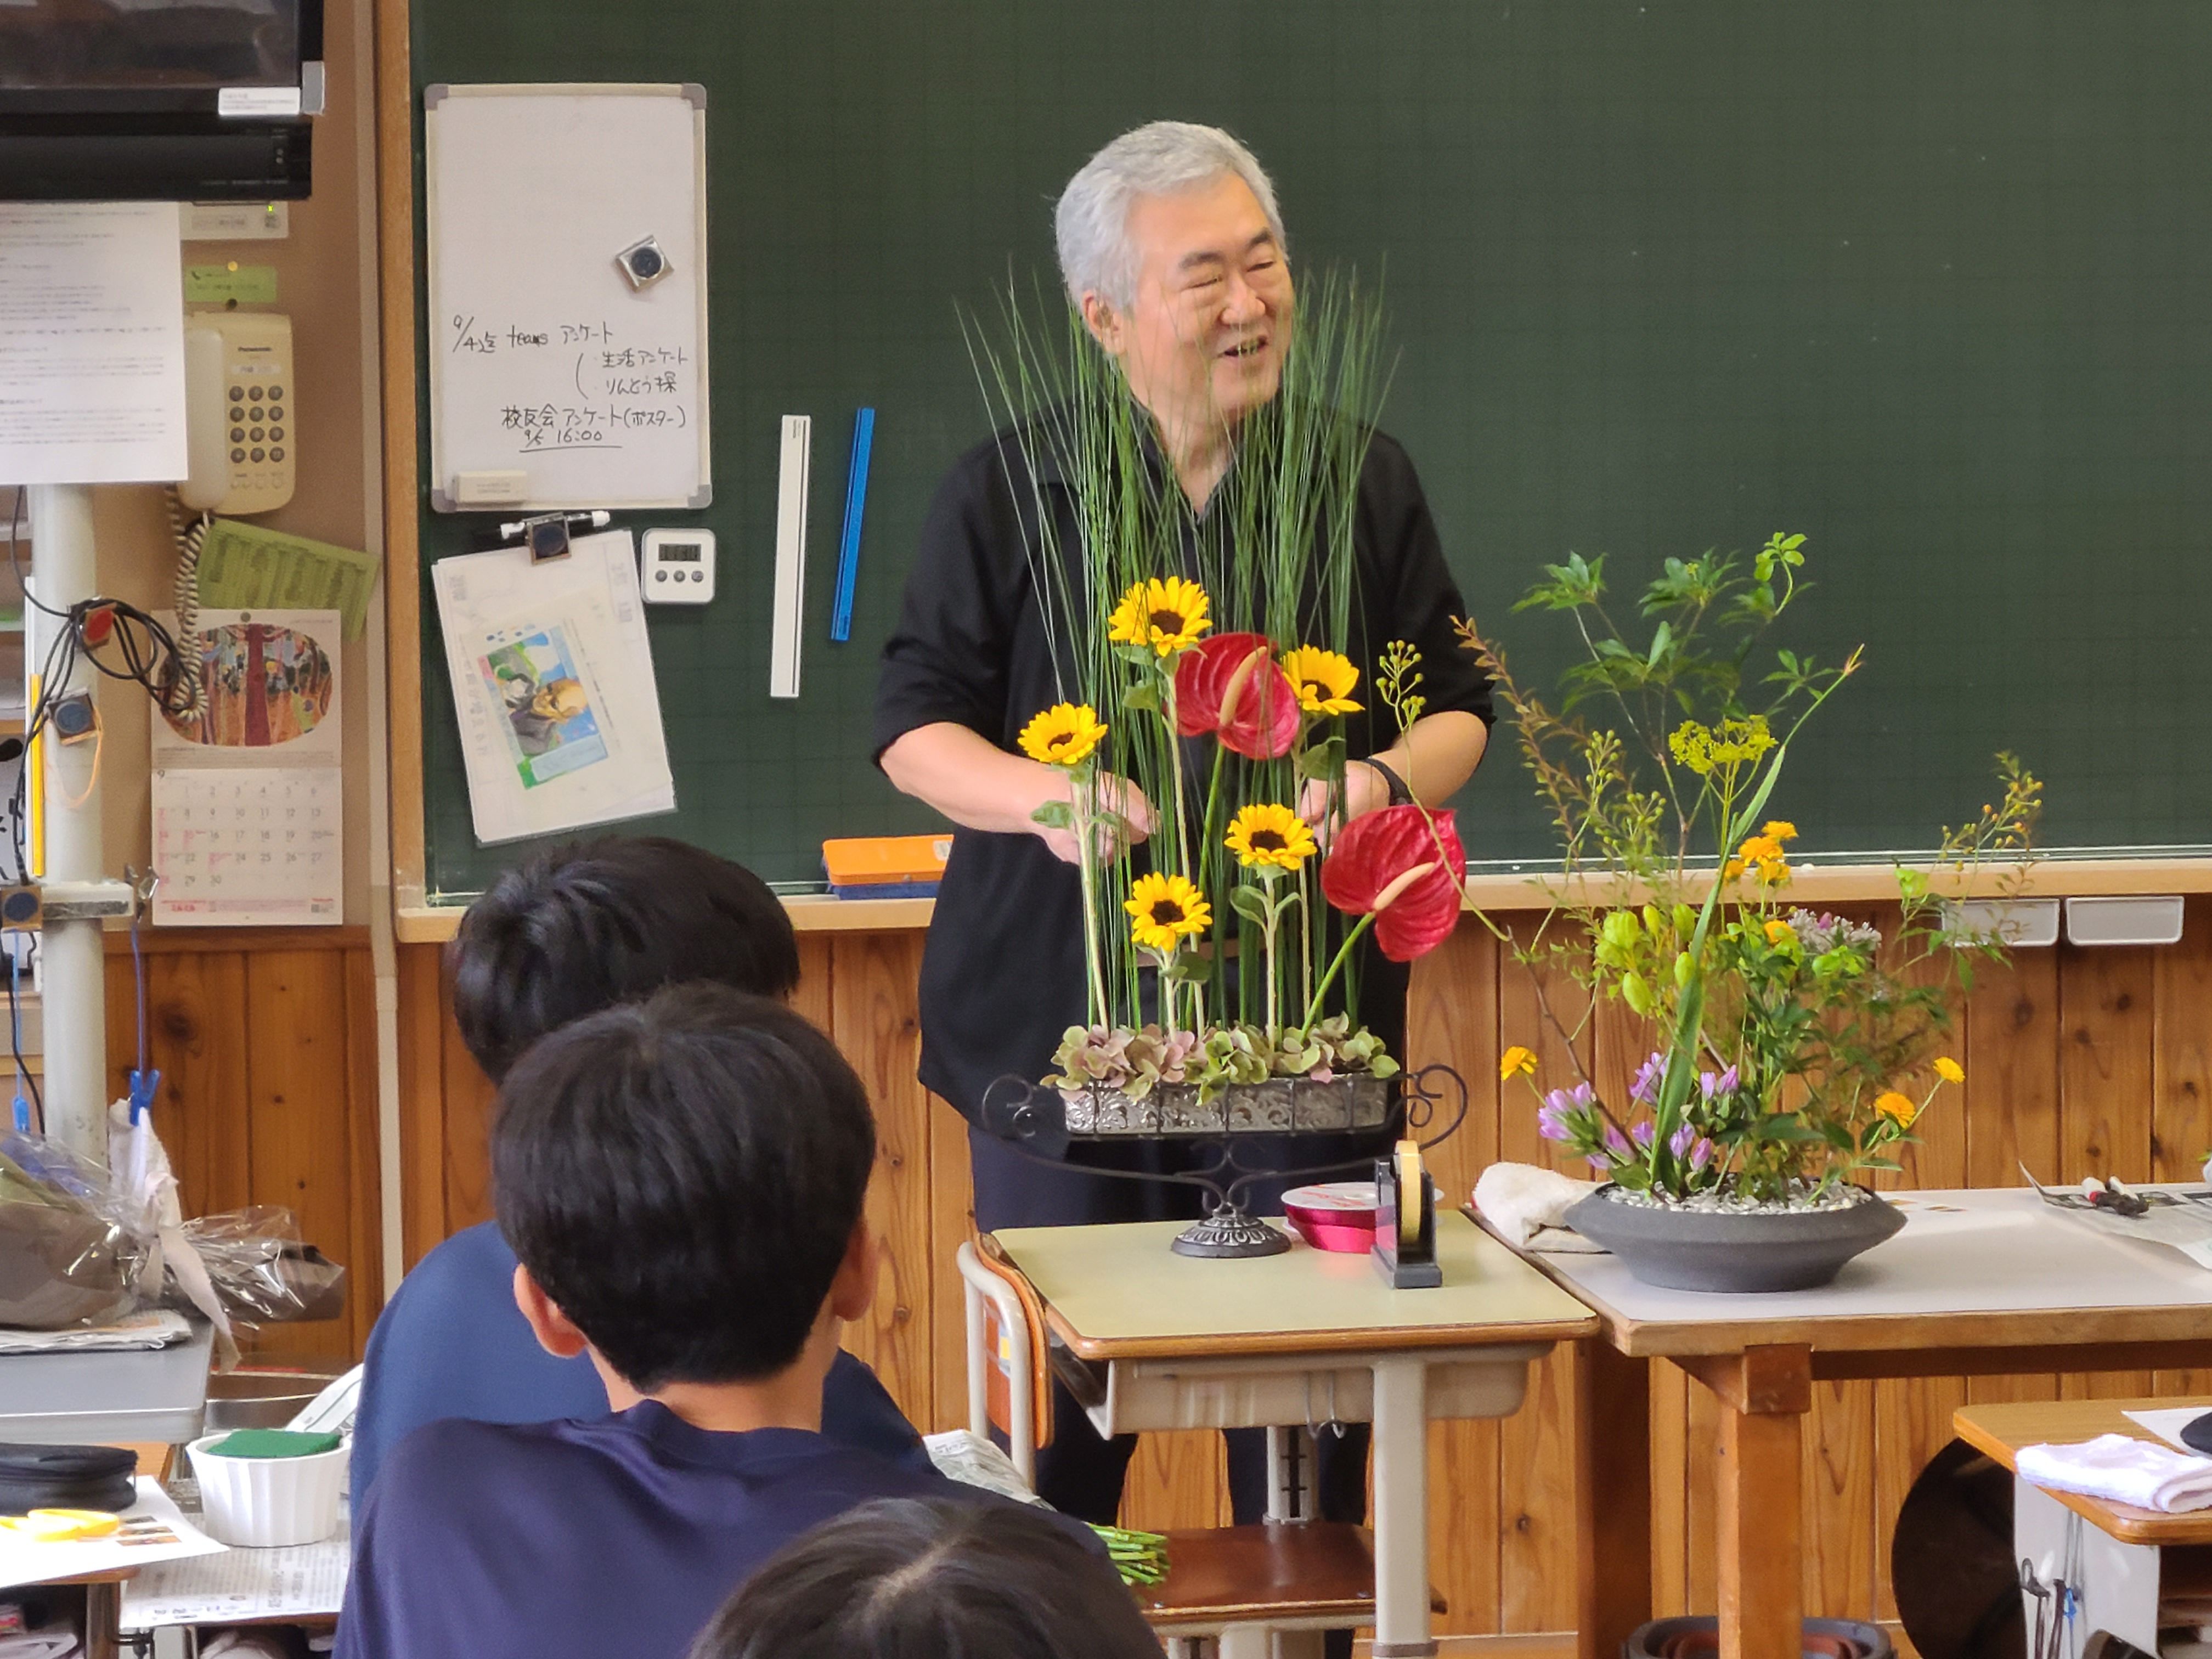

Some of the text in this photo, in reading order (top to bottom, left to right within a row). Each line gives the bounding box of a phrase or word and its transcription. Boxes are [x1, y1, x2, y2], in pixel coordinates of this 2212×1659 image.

[560, 320, 613, 345] アンケート
[557, 427, 602, 444] 16:00
